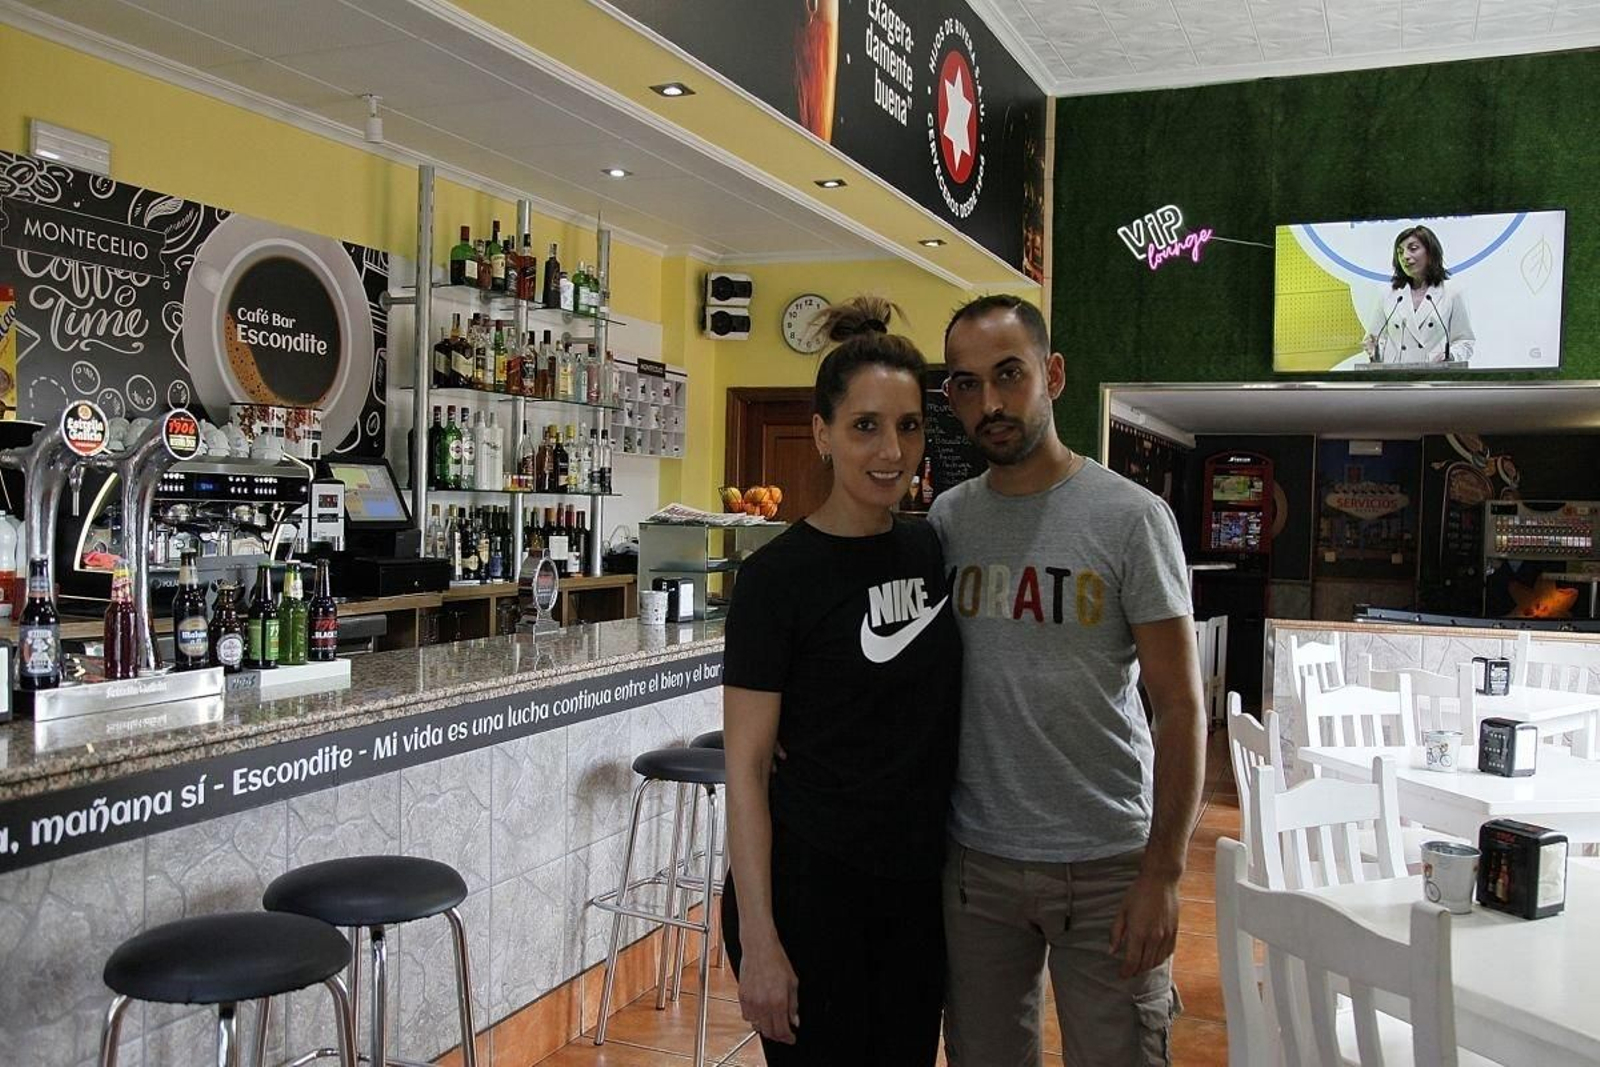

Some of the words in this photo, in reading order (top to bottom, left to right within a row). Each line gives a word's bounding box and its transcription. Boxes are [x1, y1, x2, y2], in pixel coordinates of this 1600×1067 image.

[866, 22, 913, 92] damente
[928, 26, 945, 74] HIJOS
[944, 18, 954, 35] DE
[24, 217, 148, 260] MONTECELIO
[1116, 204, 1183, 260] VIP
[1147, 228, 1213, 270] lounge
[29, 284, 149, 352] Time
[236, 323, 328, 356] Escondite
[237, 307, 269, 325] Café
[272, 312, 296, 329] Bar
[868, 577, 932, 628] NIKE
[950, 565, 1105, 627] ORATO
[31, 796, 173, 846] mañana
[180, 774, 207, 808] sí
[233, 745, 353, 796] Escondite
[373, 731, 398, 761] Mi
[402, 723, 443, 752] vida
[447, 720, 468, 741] es
[472, 712, 504, 736] una
[507, 701, 549, 728] lucha
[553, 688, 611, 716] continua
[614, 679, 646, 701] entre
[648, 674, 660, 692] el
[660, 671, 683, 690] bien
[684, 671, 694, 690] y
[693, 664, 702, 683] el
[703, 663, 722, 680] bar
